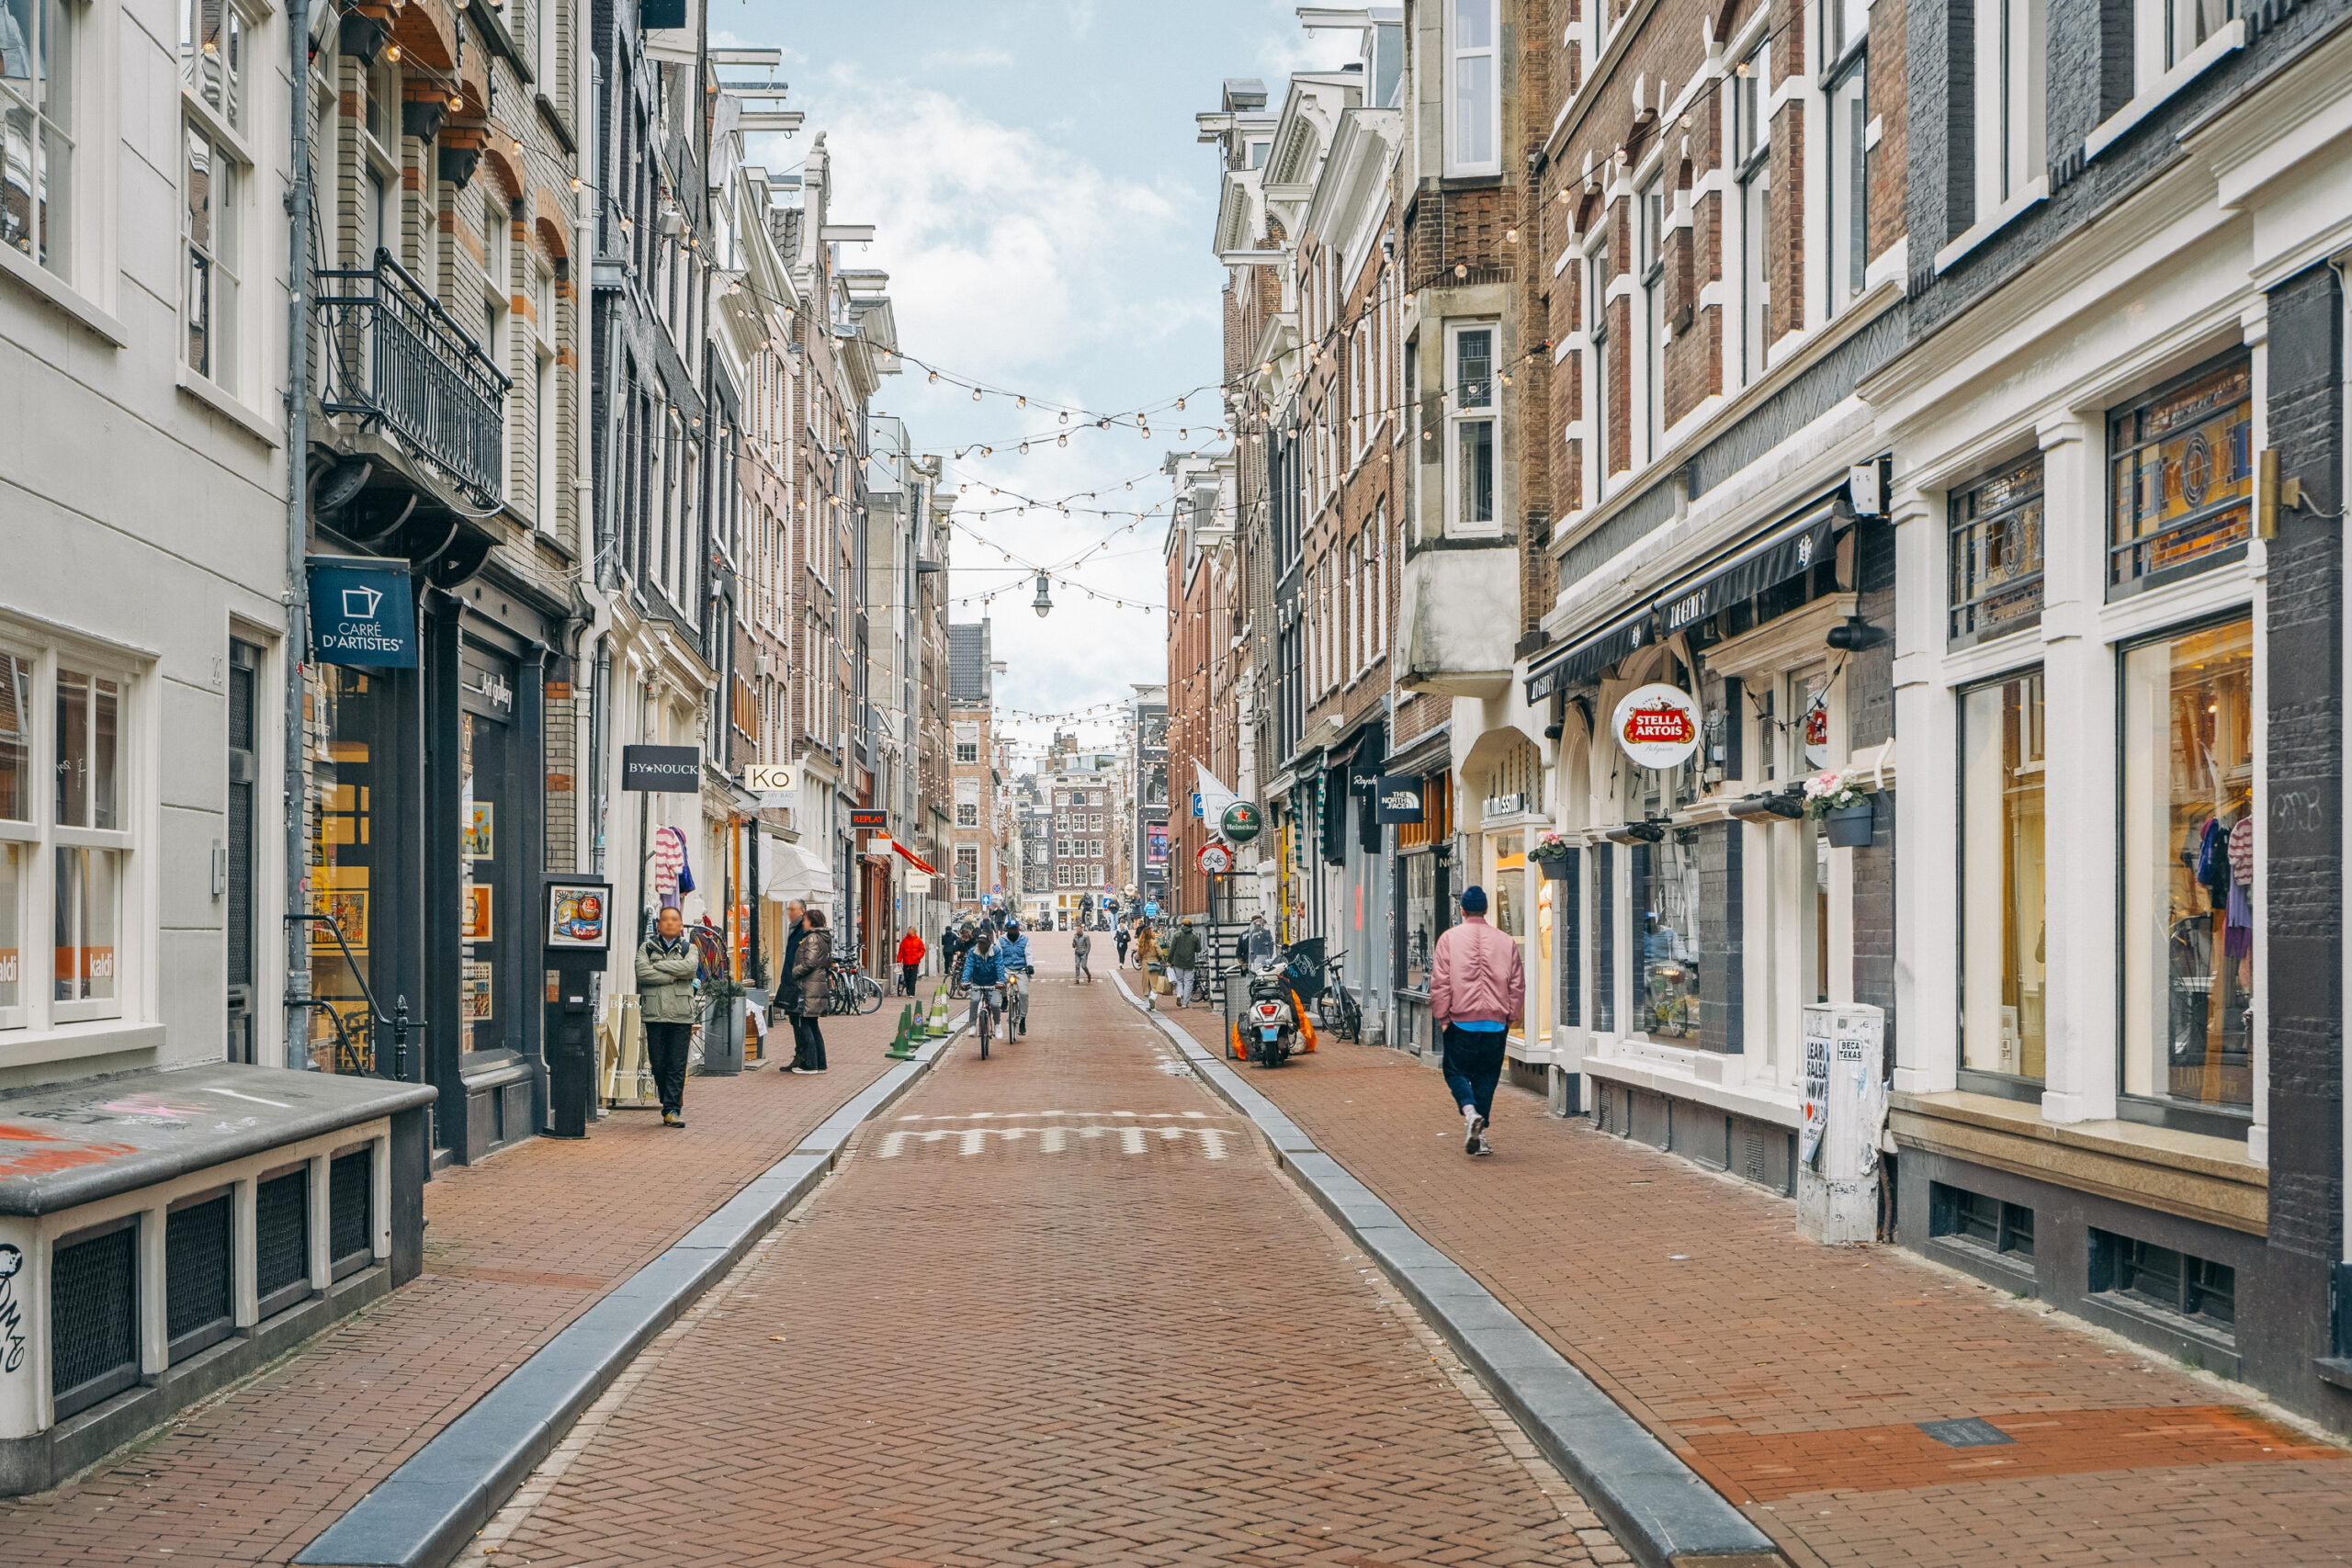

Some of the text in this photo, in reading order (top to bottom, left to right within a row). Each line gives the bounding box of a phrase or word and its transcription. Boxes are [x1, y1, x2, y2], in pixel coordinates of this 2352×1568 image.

[338, 621, 382, 637] CARRÉ
[482, 671, 513, 713] Art gallery
[1635, 715, 1682, 726] STELLA
[1635, 726, 1683, 736] ARTOIS
[653, 763, 698, 775] NOUCK
[1353, 773, 1377, 790] Raph
[854, 815, 884, 823] REPLAY
[0, 955, 17, 982] aldi
[90, 953, 113, 977] kaldi
[1841, 1042, 1860, 1050] BECA
[1839, 1050, 1861, 1059] TEKAS
[1806, 1060, 1826, 1079] SALSA
[1805, 1079, 1825, 1100] NOW
